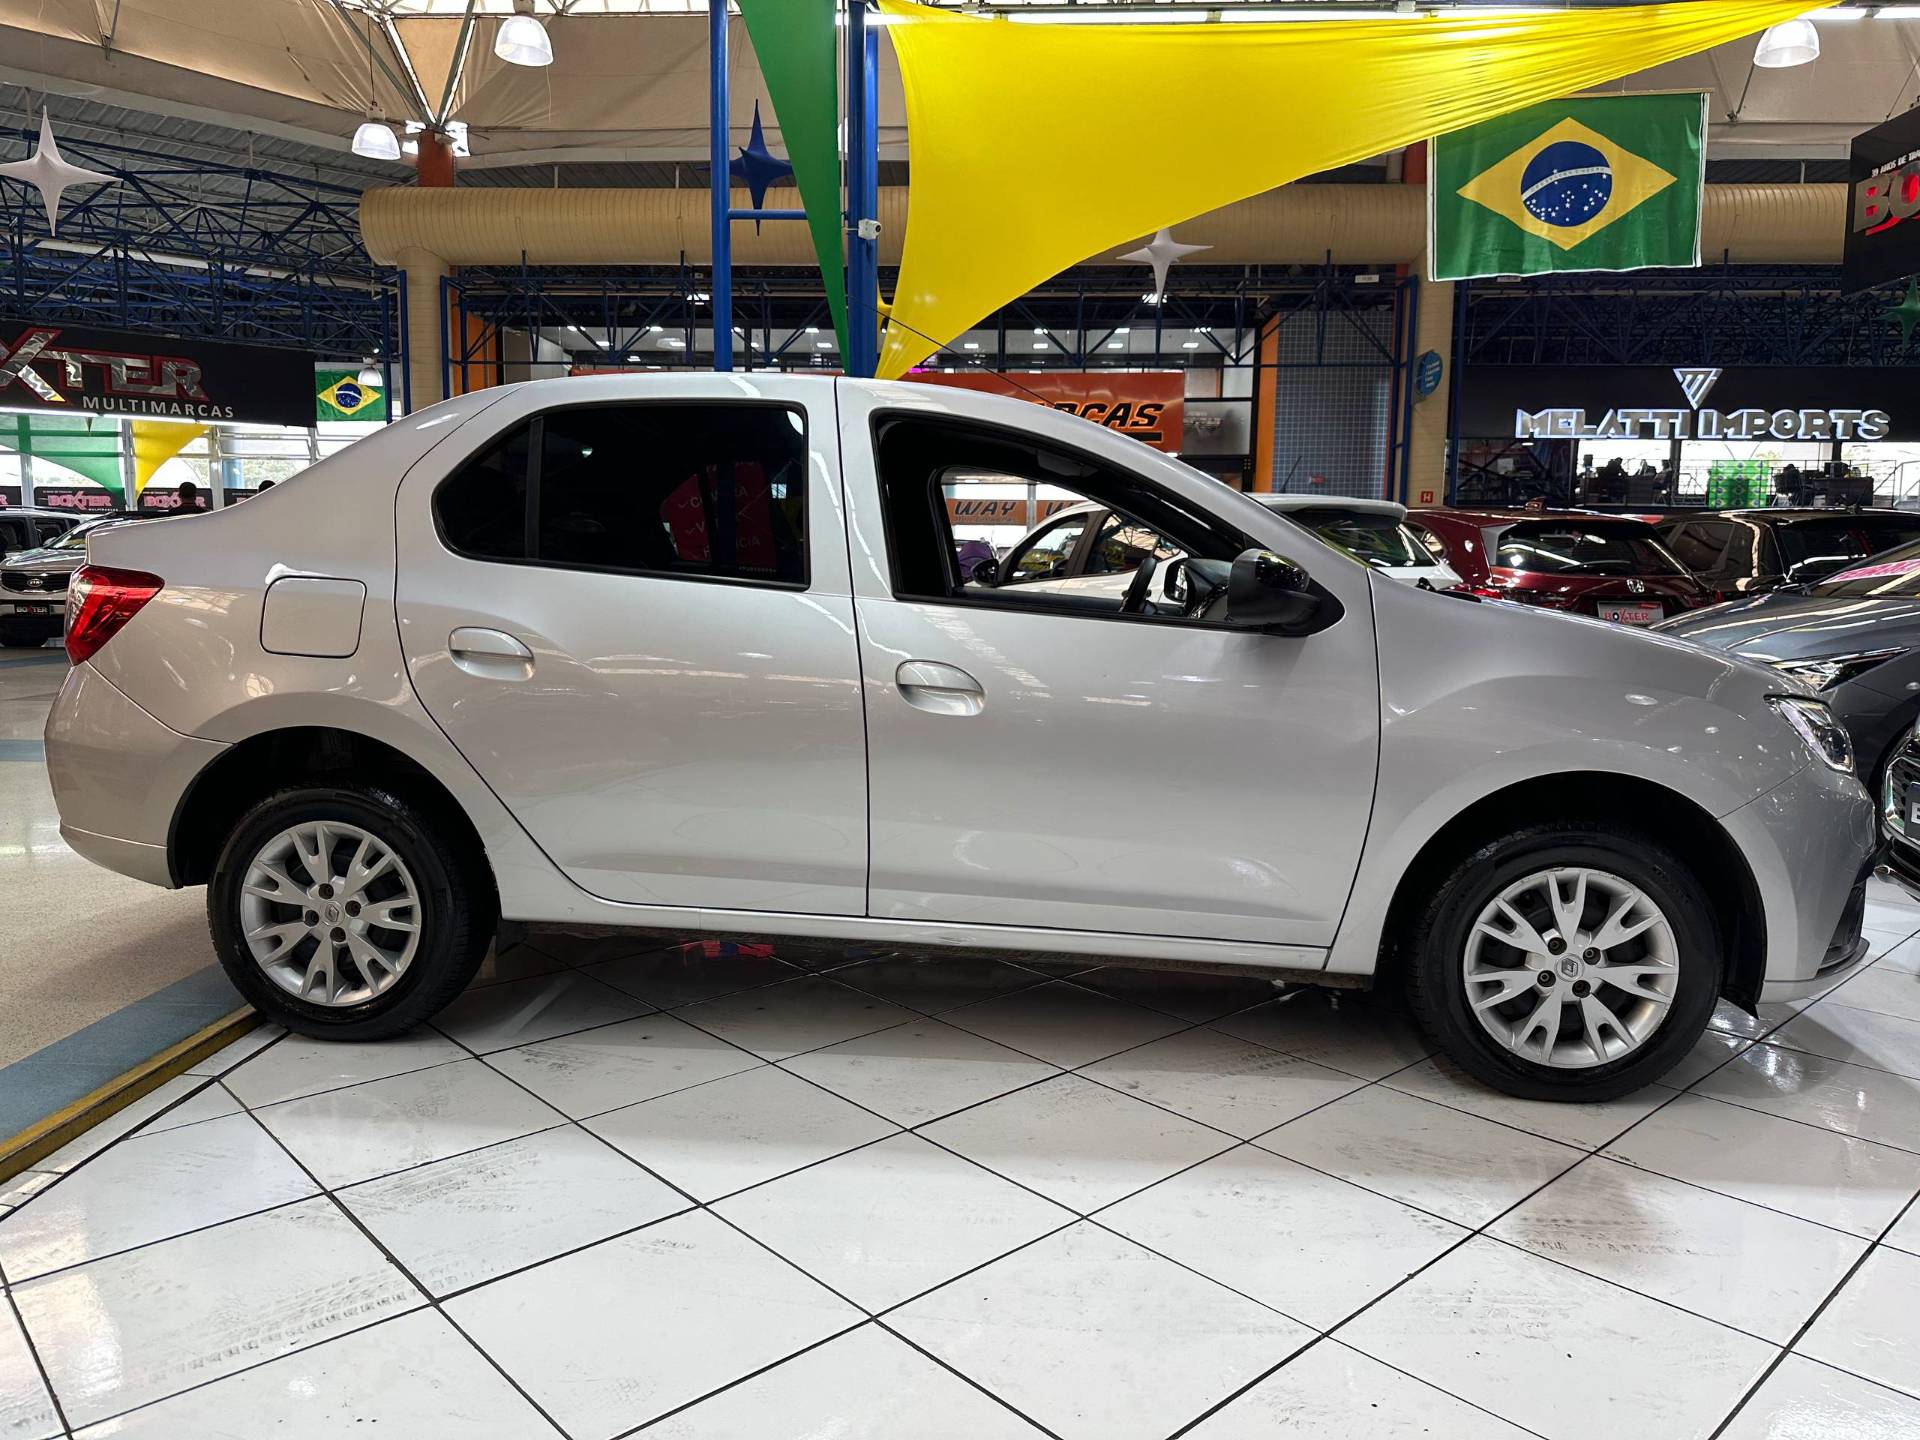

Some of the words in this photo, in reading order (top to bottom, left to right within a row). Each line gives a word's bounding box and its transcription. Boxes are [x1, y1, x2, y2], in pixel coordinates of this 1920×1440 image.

[0, 328, 208, 402] XTER
[82, 395, 234, 418] MULTIMARCAS
[1515, 408, 1691, 439] MELATTI
[1698, 409, 1892, 440] IMPORTS
[47, 490, 112, 511] BOXTER
[955, 500, 1017, 517] WAY
[1603, 608, 1649, 624] BOXTER
